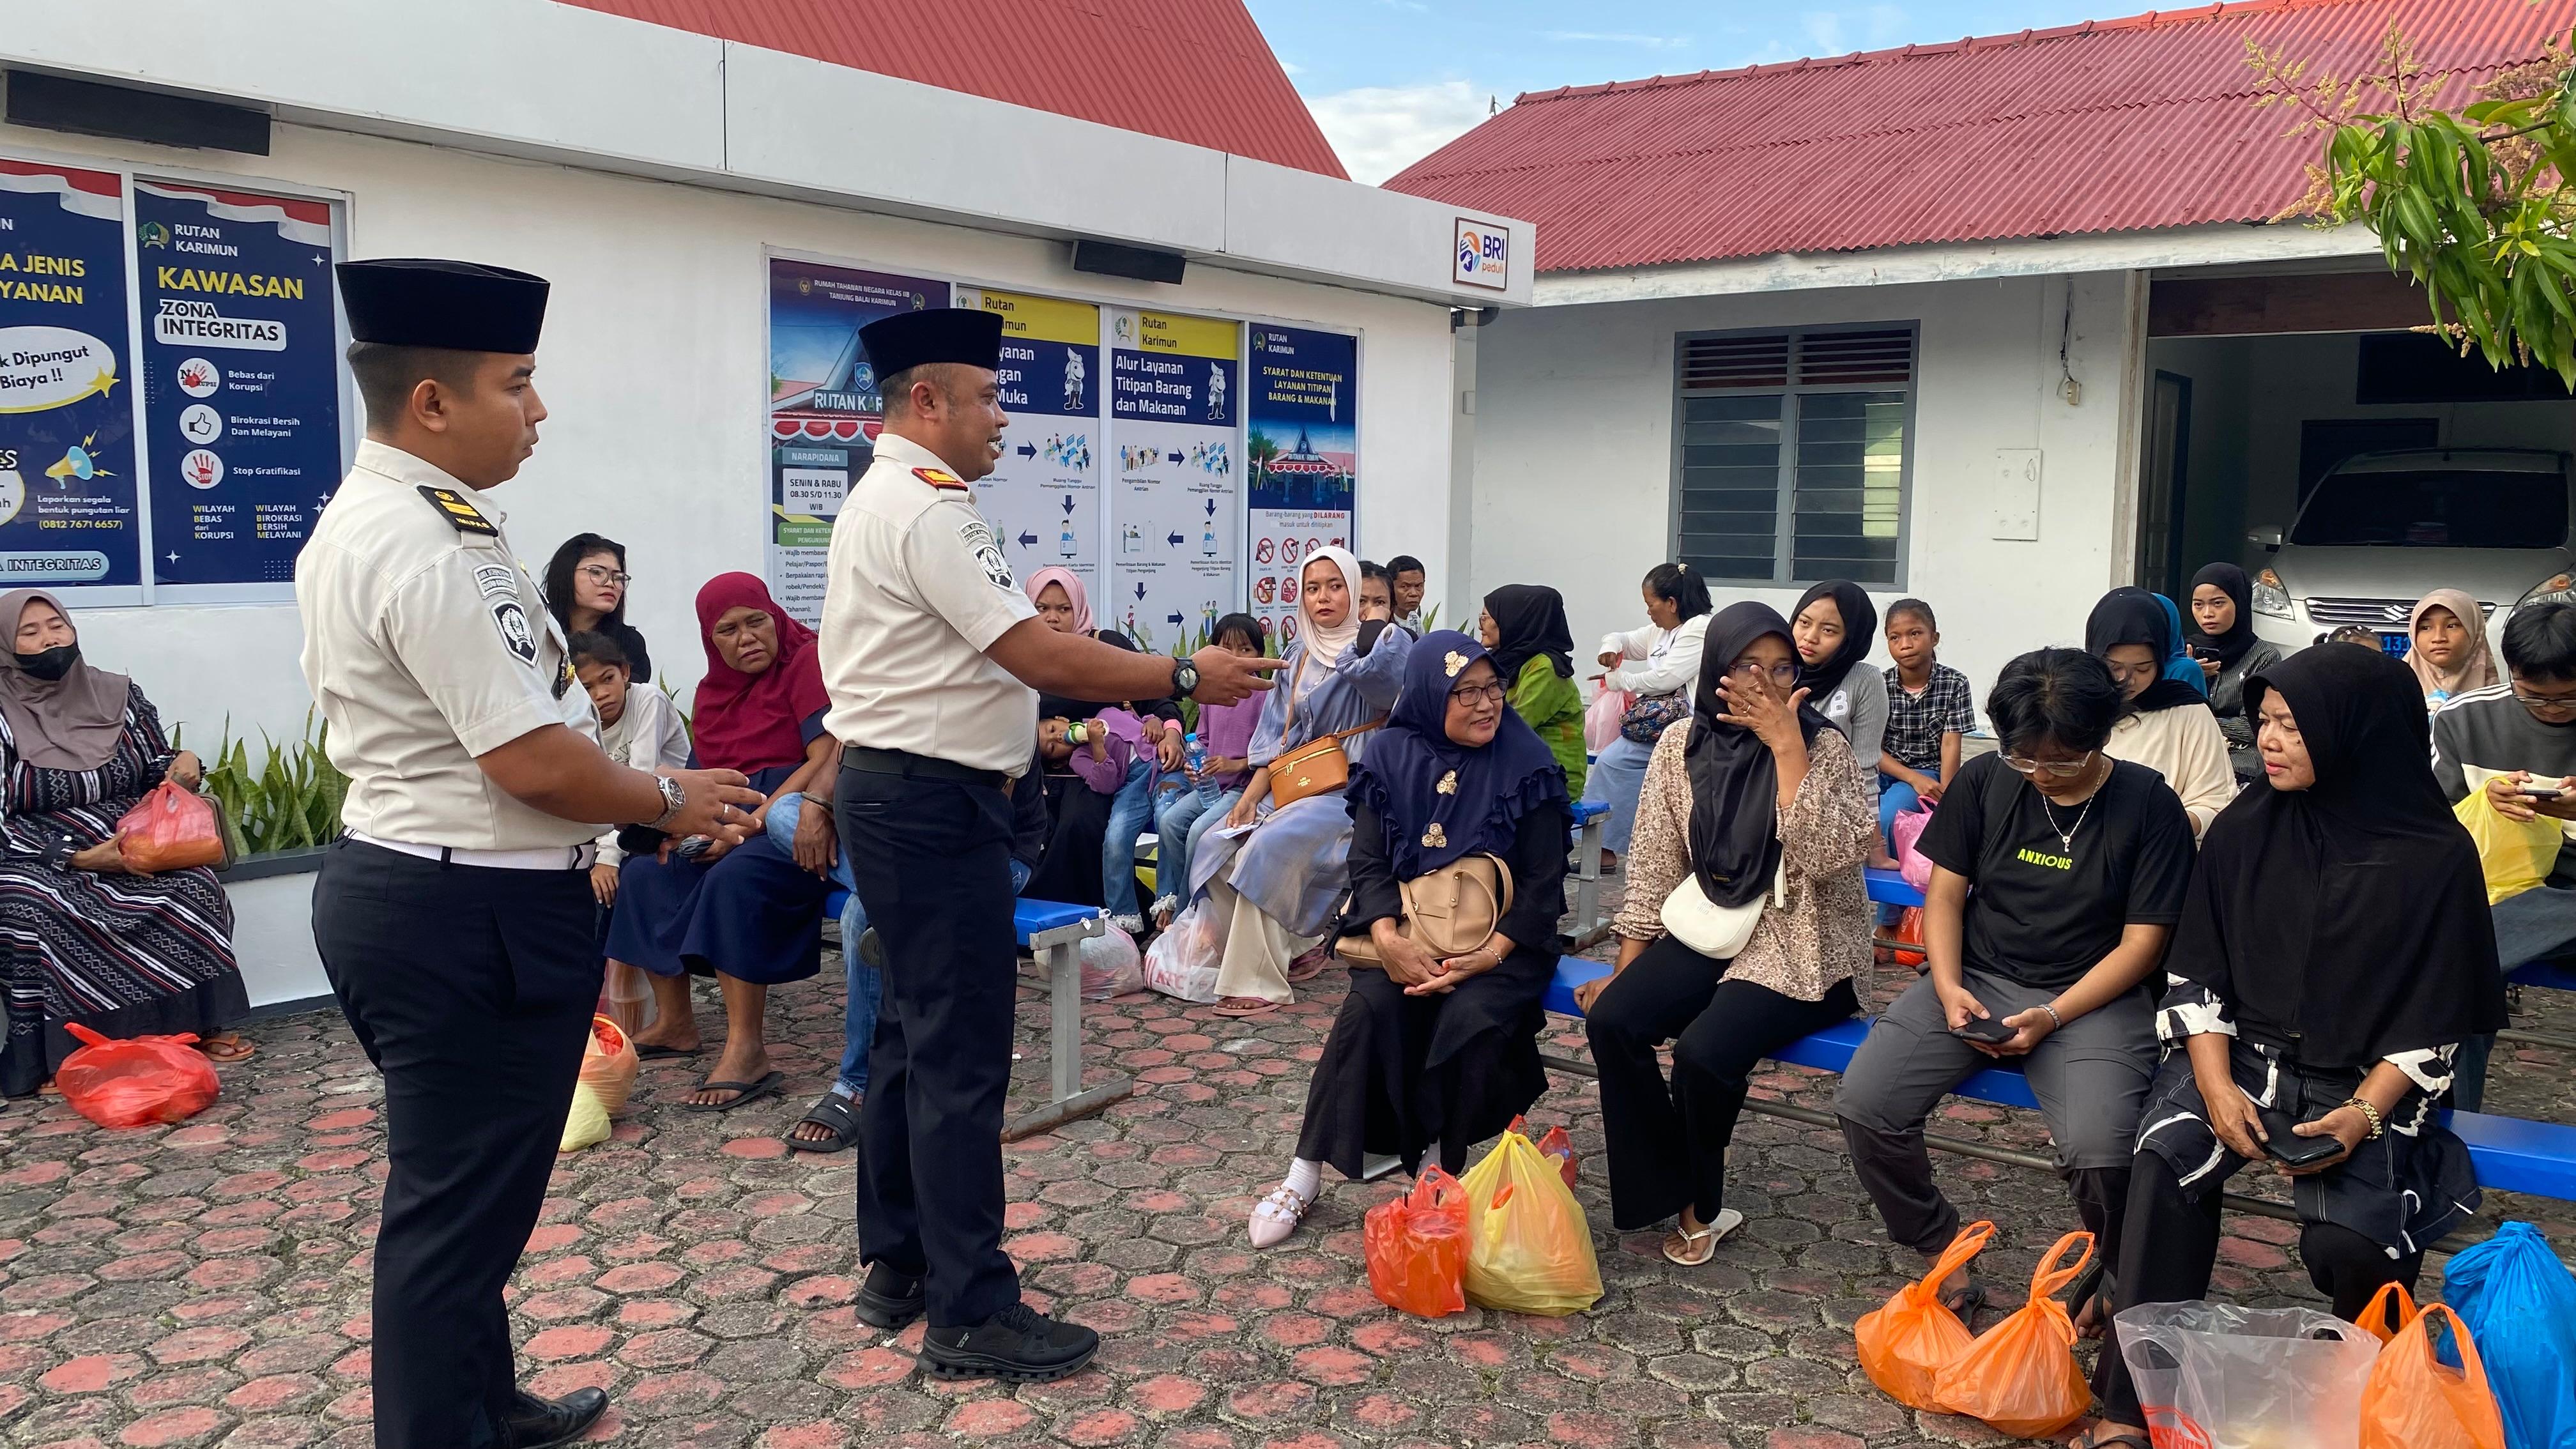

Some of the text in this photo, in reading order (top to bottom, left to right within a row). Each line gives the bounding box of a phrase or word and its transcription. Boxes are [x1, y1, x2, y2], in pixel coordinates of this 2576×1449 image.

[174, 224, 220, 239] RUTAN
[176, 241, 238, 257] KARIMUN
[1483, 235, 1505, 261] BRI
[23, 256, 85, 277] JENIS
[1482, 263, 1503, 273] peduli
[158, 266, 303, 300] KAWASAN
[814, 280, 835, 288] RUMAH
[836, 282, 862, 291] TAHANAN
[864, 286, 885, 294] NEGARA
[829, 292, 854, 302] TANJUNG
[871, 298, 896, 307] KARIMUN
[985, 296, 1015, 311] Rutan
[162, 300, 217, 318] ZONA
[163, 319, 279, 341] INTEGRITAS
[1142, 317, 1167, 330] Rutan
[1142, 334, 1177, 348] Karimun
[1268, 333, 1287, 343] RUTAN
[12, 346, 89, 367] Dipungut
[1268, 344, 1294, 355] KARIMUN
[1116, 355, 1183, 376] Alur Layanan
[0, 374, 48, 389] Biaya
[228, 371, 275, 380] Bebas dari
[1263, 366, 1342, 383] SYARAT DAN KETENTUAN
[229, 383, 263, 392] Korupsi
[1116, 376, 1192, 399] Titipan Barang
[1274, 380, 1331, 394] LAYANAN TITIPAN
[815, 392, 855, 411] RUTAN
[1268, 392, 1296, 403] BARANG
[1304, 396, 1337, 406] MAKANAN
[1116, 397, 1186, 416] dan Makanan
[231, 416, 300, 425] Birokrasi Bersih
[251, 428, 291, 438] Melayani
[0, 449, 17, 468] S
[792, 452, 839, 463] NARAPIDANA
[233, 467, 301, 476] Stop Gratifikasi
[822, 480, 841, 488] RABU
[37, 495, 111, 504] Laporkan segala
[71, 507, 114, 515] pungutan
[1266, 510, 1301, 519] Barang-barang
[39, 520, 67, 530] (0812
[95, 521, 123, 530] 6657)
[456, 518, 489, 528] IMIPAS
[8, 558, 101, 571] INTEGRITAS
[1829, 690, 1848, 717] B
[2017, 848, 2073, 870] ANXIOUS
